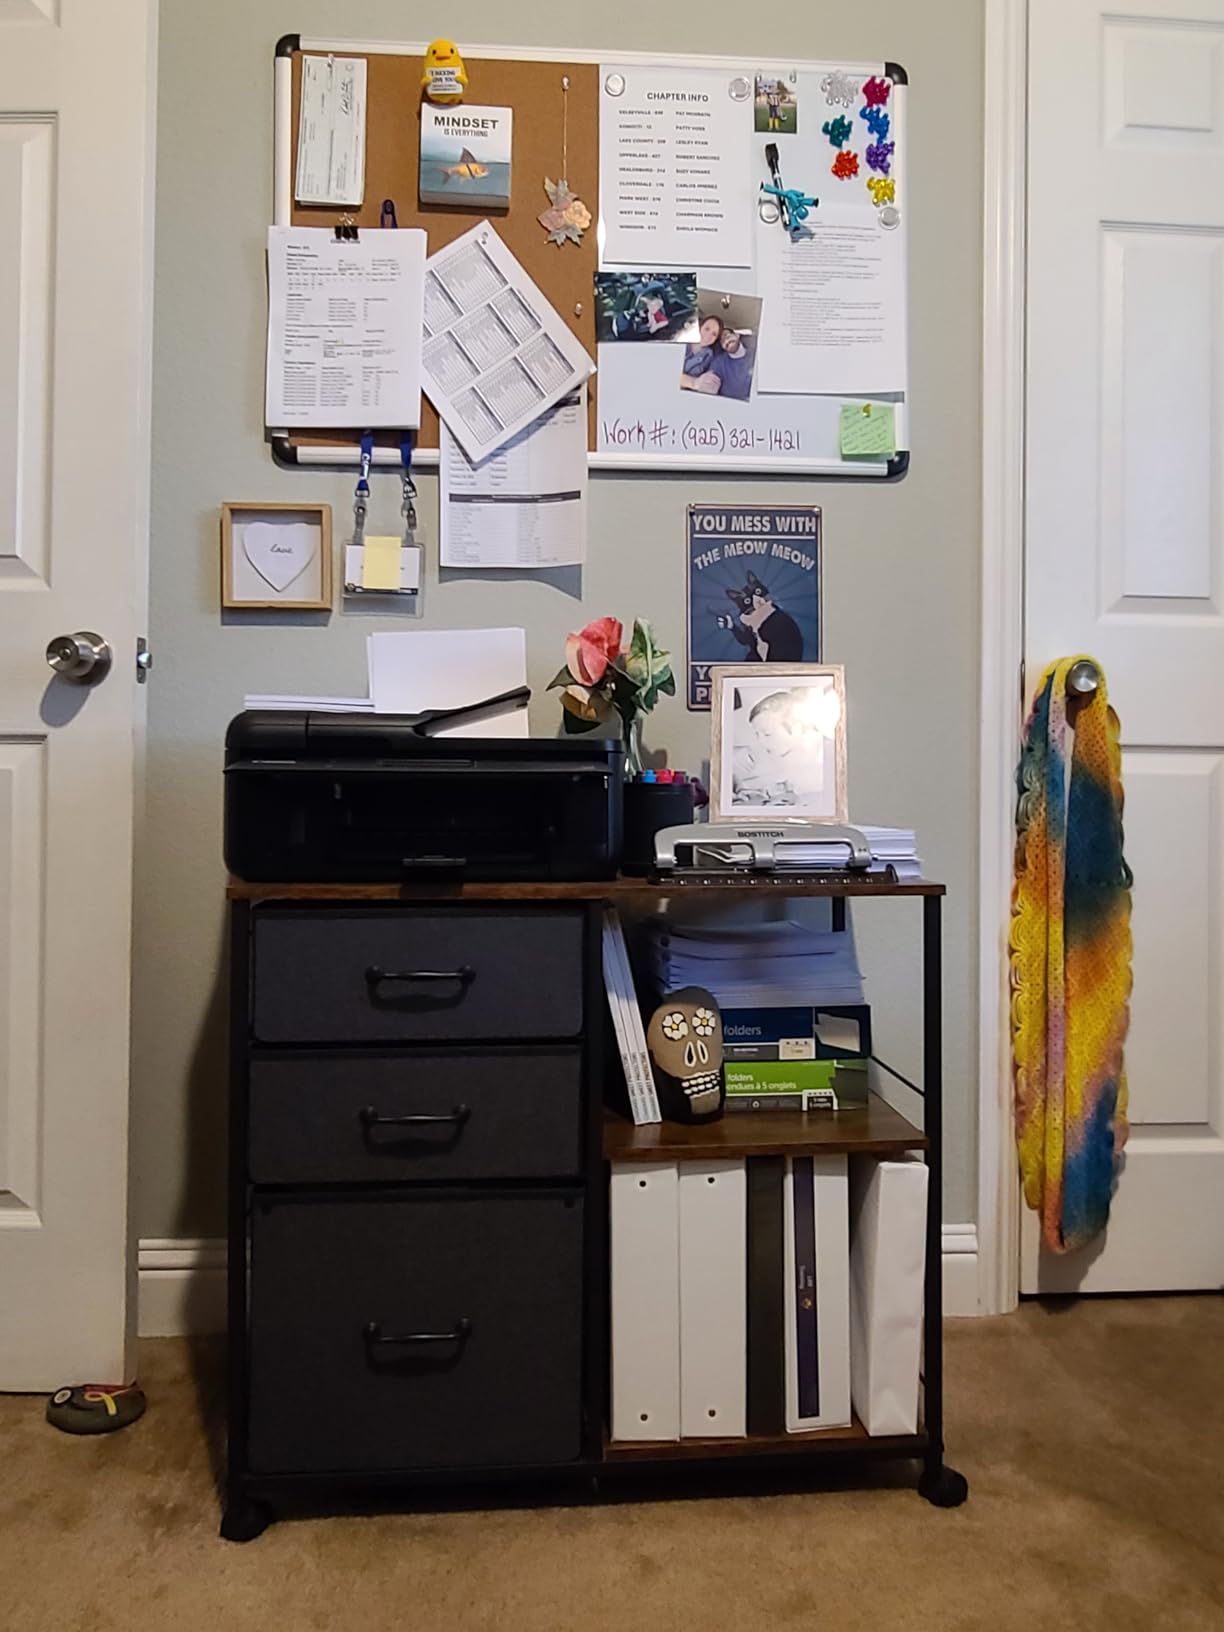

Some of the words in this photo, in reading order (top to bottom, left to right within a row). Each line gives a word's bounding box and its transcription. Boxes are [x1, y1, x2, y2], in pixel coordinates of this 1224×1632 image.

[646, 92, 686, 101] CHAPTER
[688, 94, 709, 102] INFO
[434, 116, 499, 130] MINDSET
[451, 129, 488, 137] EVERYTHING
[603, 418, 646, 449] Work
[681, 420, 725, 452] (925)
[729, 427, 800, 451] 321-1421
[692, 515, 726, 532] YOU
[731, 516, 771, 532] MESS
[776, 516, 816, 533] WITH
[694, 548, 721, 570] THE
[724, 541, 768, 558] MEOW
[771, 544, 815, 571] MEOW
[724, 1025, 762, 1036] folders
